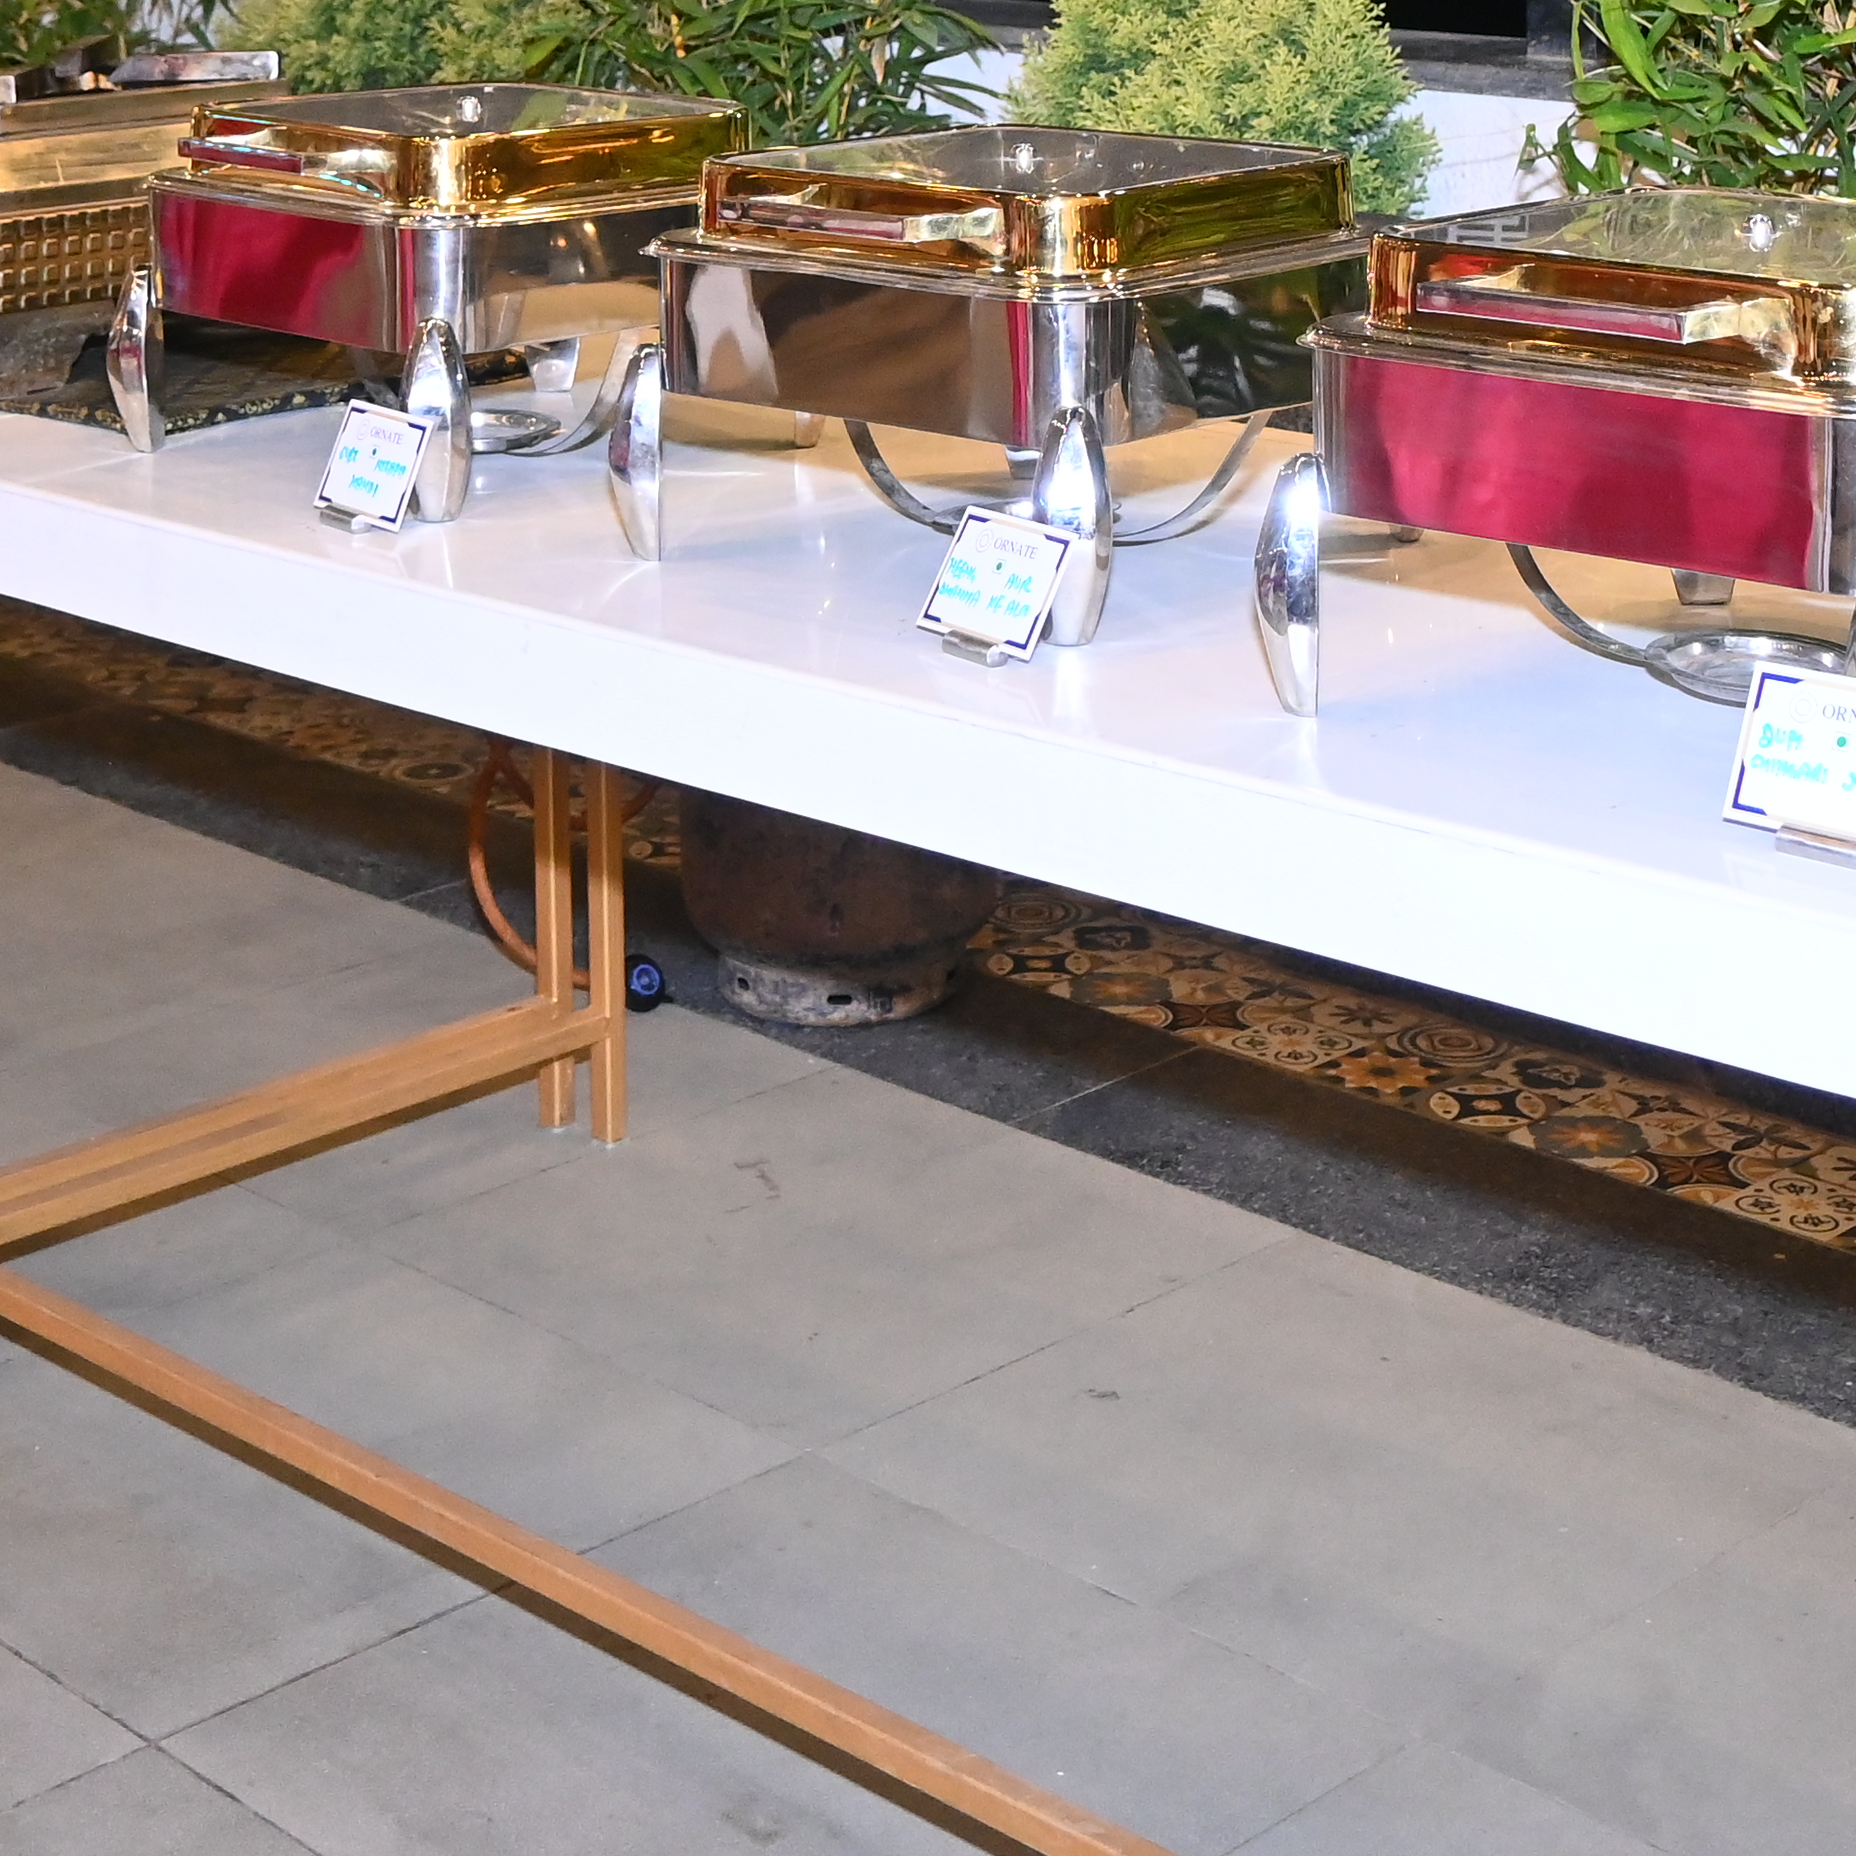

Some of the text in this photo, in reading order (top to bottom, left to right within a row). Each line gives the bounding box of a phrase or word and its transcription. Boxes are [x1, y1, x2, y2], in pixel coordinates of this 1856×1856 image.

[369, 425, 403, 444] ORNATE
[993, 537, 1038, 559] ORNATE
[1004, 572, 1033, 593] AUR
[1758, 722, 1803, 751] DUM
